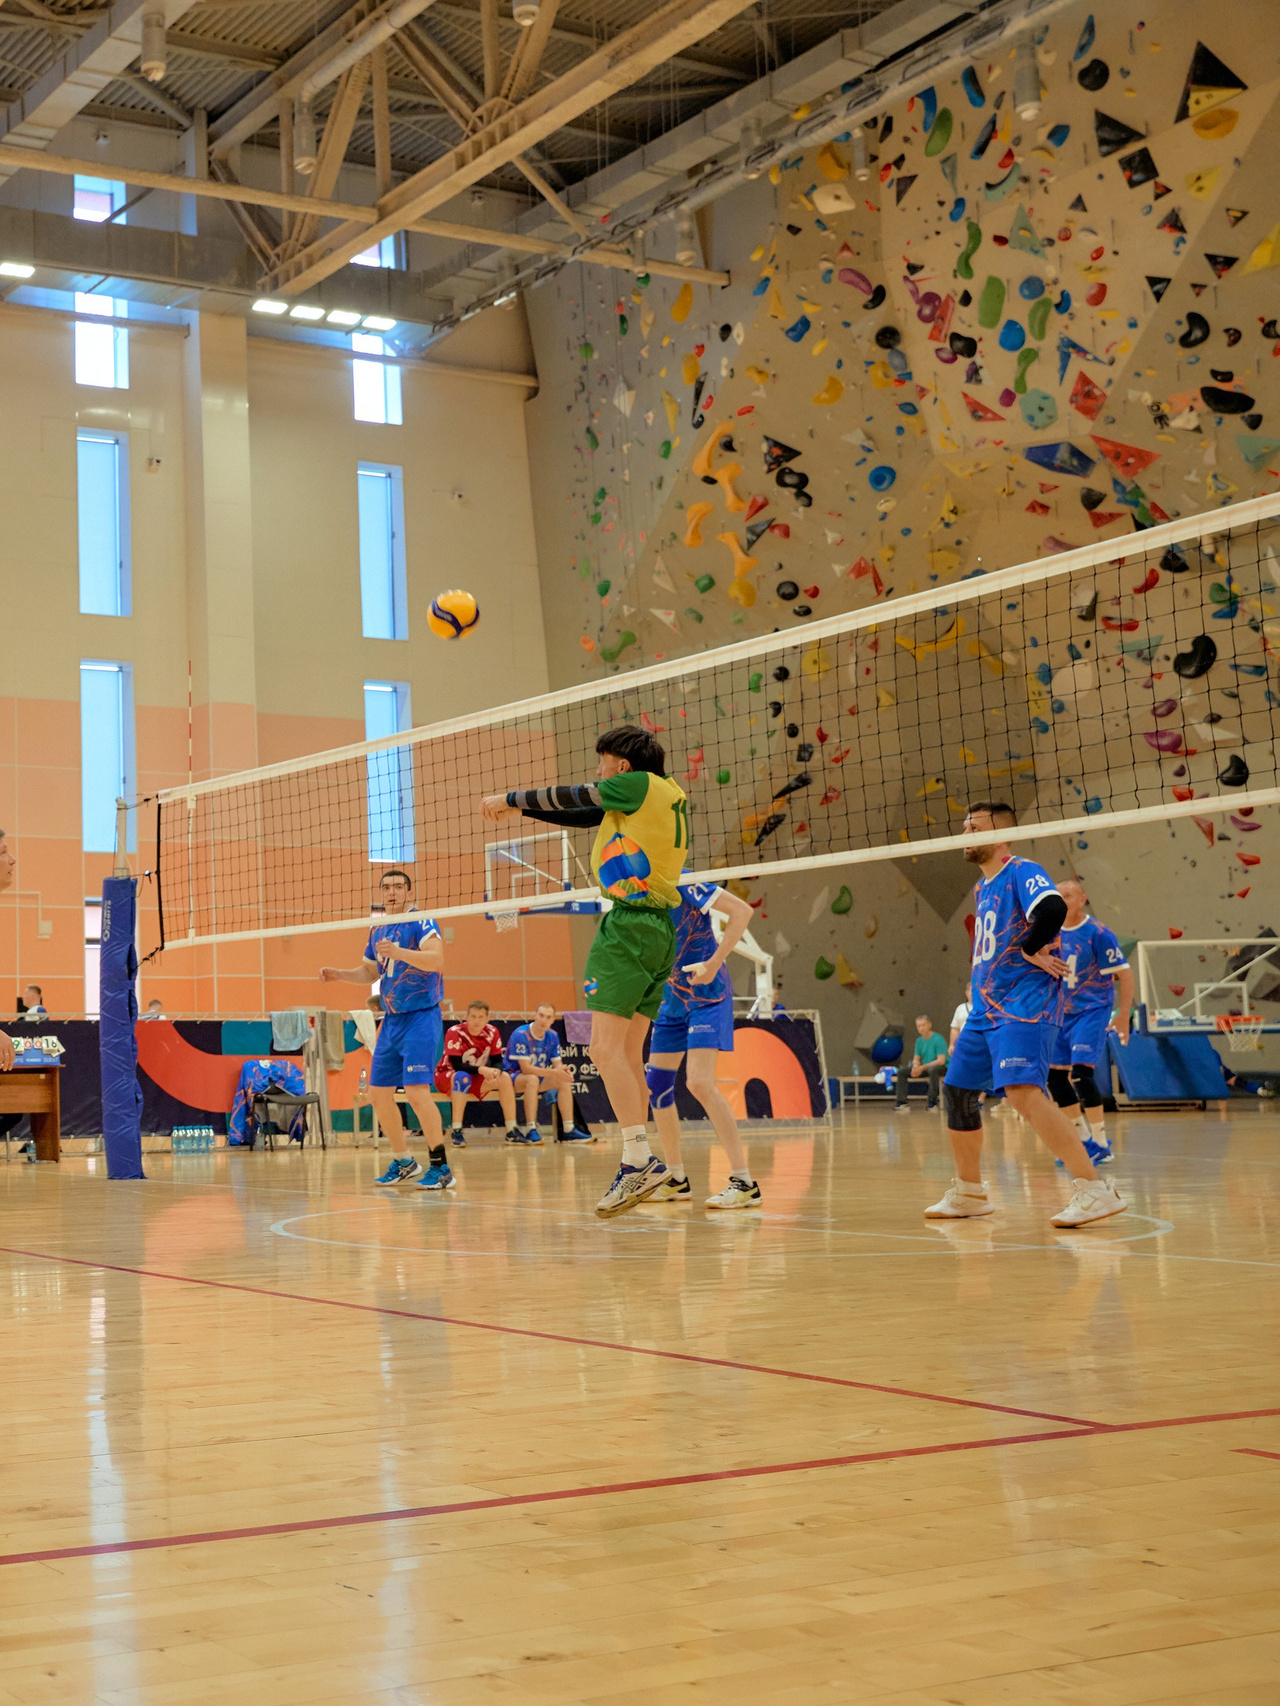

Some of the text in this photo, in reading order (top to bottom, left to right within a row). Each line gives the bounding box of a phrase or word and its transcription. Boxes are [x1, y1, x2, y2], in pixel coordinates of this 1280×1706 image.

[671, 798, 689, 850] 11
[1026, 874, 1050, 896] 28
[972, 910, 997, 967] 28
[1106, 947, 1124, 964] 24
[44, 1038, 58, 1048] 16
[515, 1043, 526, 1054] 23
